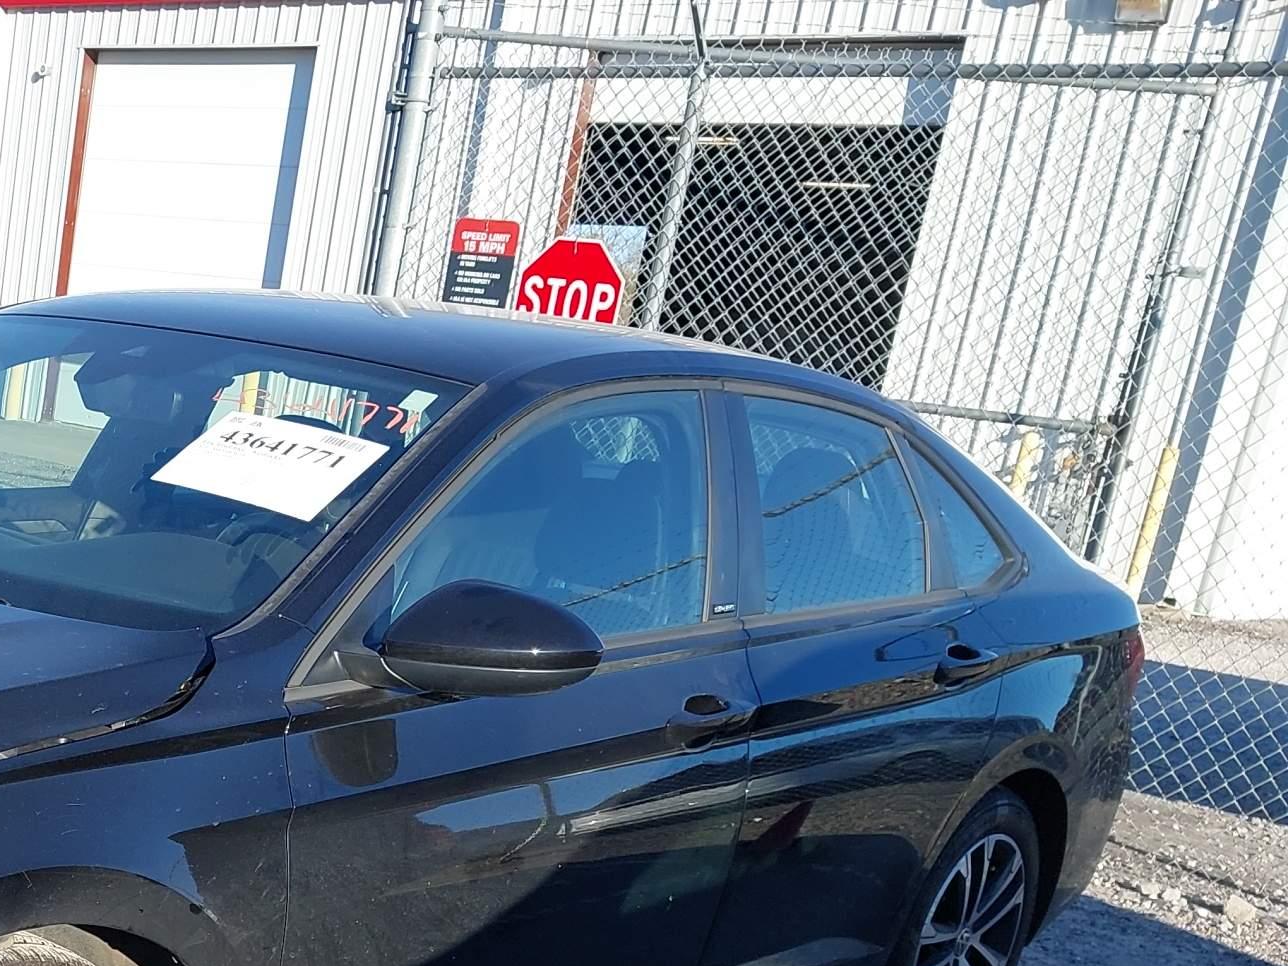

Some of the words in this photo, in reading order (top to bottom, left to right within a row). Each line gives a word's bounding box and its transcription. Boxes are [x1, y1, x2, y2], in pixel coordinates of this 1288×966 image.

[461, 231, 488, 241] SPEED
[488, 233, 511, 243] LIMIT
[464, 240, 477, 252] 15
[478, 241, 506, 255] MPH
[518, 274, 616, 323] STOP
[220, 430, 346, 468] 43641771
